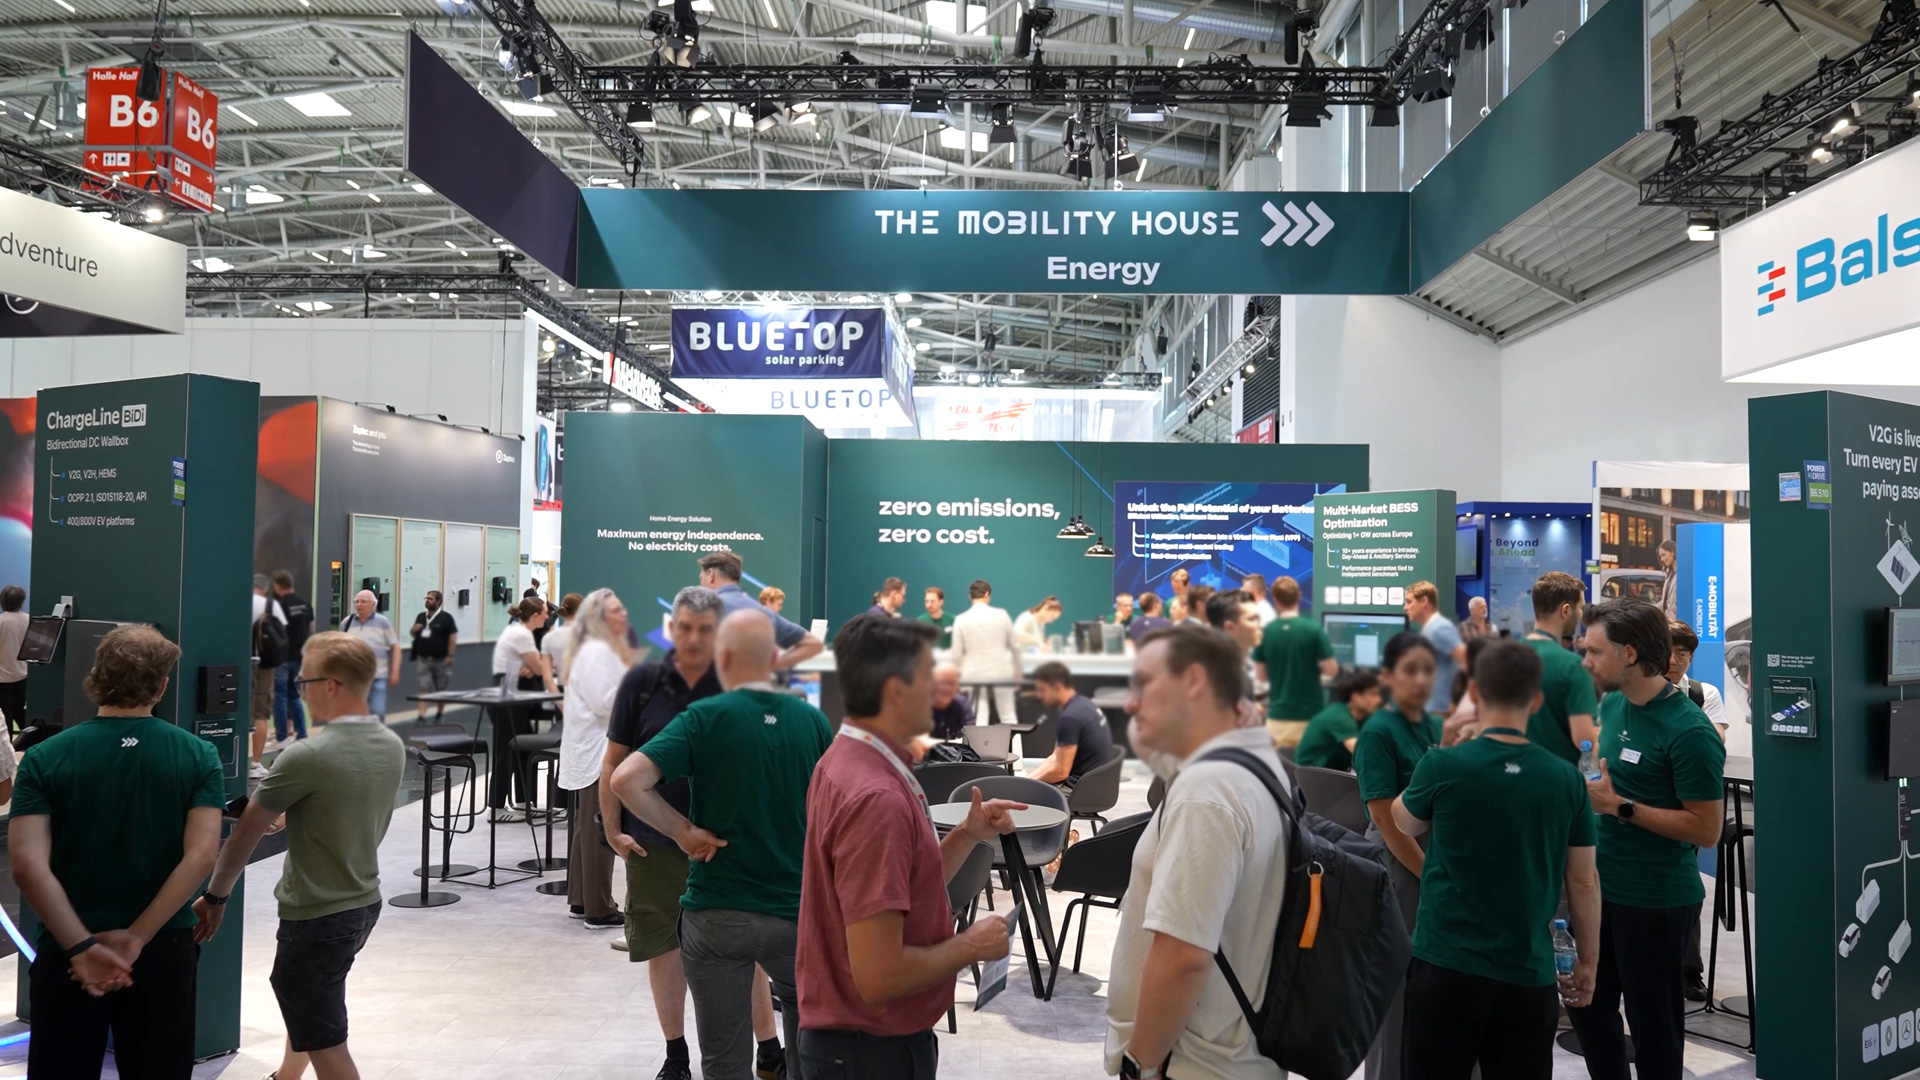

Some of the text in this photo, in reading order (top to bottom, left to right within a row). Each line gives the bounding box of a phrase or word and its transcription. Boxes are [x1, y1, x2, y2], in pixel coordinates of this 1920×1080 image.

[93, 72, 138, 80] Halle Hall
[178, 77, 204, 99] Halle Hall
[110, 95, 159, 128] B6
[187, 106, 215, 150] B6
[875, 210, 1240, 236] THE MOBILITY HOUSE
[1047, 257, 1160, 286] Energy
[690, 321, 864, 350] BLUETOP
[765, 354, 844, 366] solar parking
[771, 389, 892, 409] BLUETOP
[47, 407, 145, 431] ChargeLine BiDi
[47, 435, 129, 450] Bidirectional DC Wallbox
[1868, 424, 1892, 444] V2G
[1894, 428, 1903, 445] is
[1843, 448, 1918, 475] Turn every EV
[69, 469, 117, 480] V2G, V2H, HEMS
[67, 491, 147, 503] OCPP 2.1, ISO15118-20, API
[1863, 479, 1899, 501] paying
[879, 498, 1061, 520] zero emissions,
[1127, 502, 1159, 512] Unlock
[1160, 503, 1177, 512] the
[1195, 503, 1238, 513] Potential
[1239, 504, 1250, 513] of
[1250, 505, 1271, 515] your
[1323, 502, 1419, 516] Multi-Market BESS
[67, 516, 135, 528] 400/800V EV platforms
[1323, 517, 1388, 530] Optimization
[597, 529, 764, 541] Maximum energy independence.
[878, 526, 995, 544] zero cost.
[1322, 532, 1352, 540] Optimizing
[1392, 530, 1413, 538] Europe
[628, 541, 732, 553] No electricity costs.
[1496, 538, 1539, 549] Beyond
[1498, 548, 1535, 557] Ahead
[1708, 576, 1718, 638] E-MOBILITÄT
